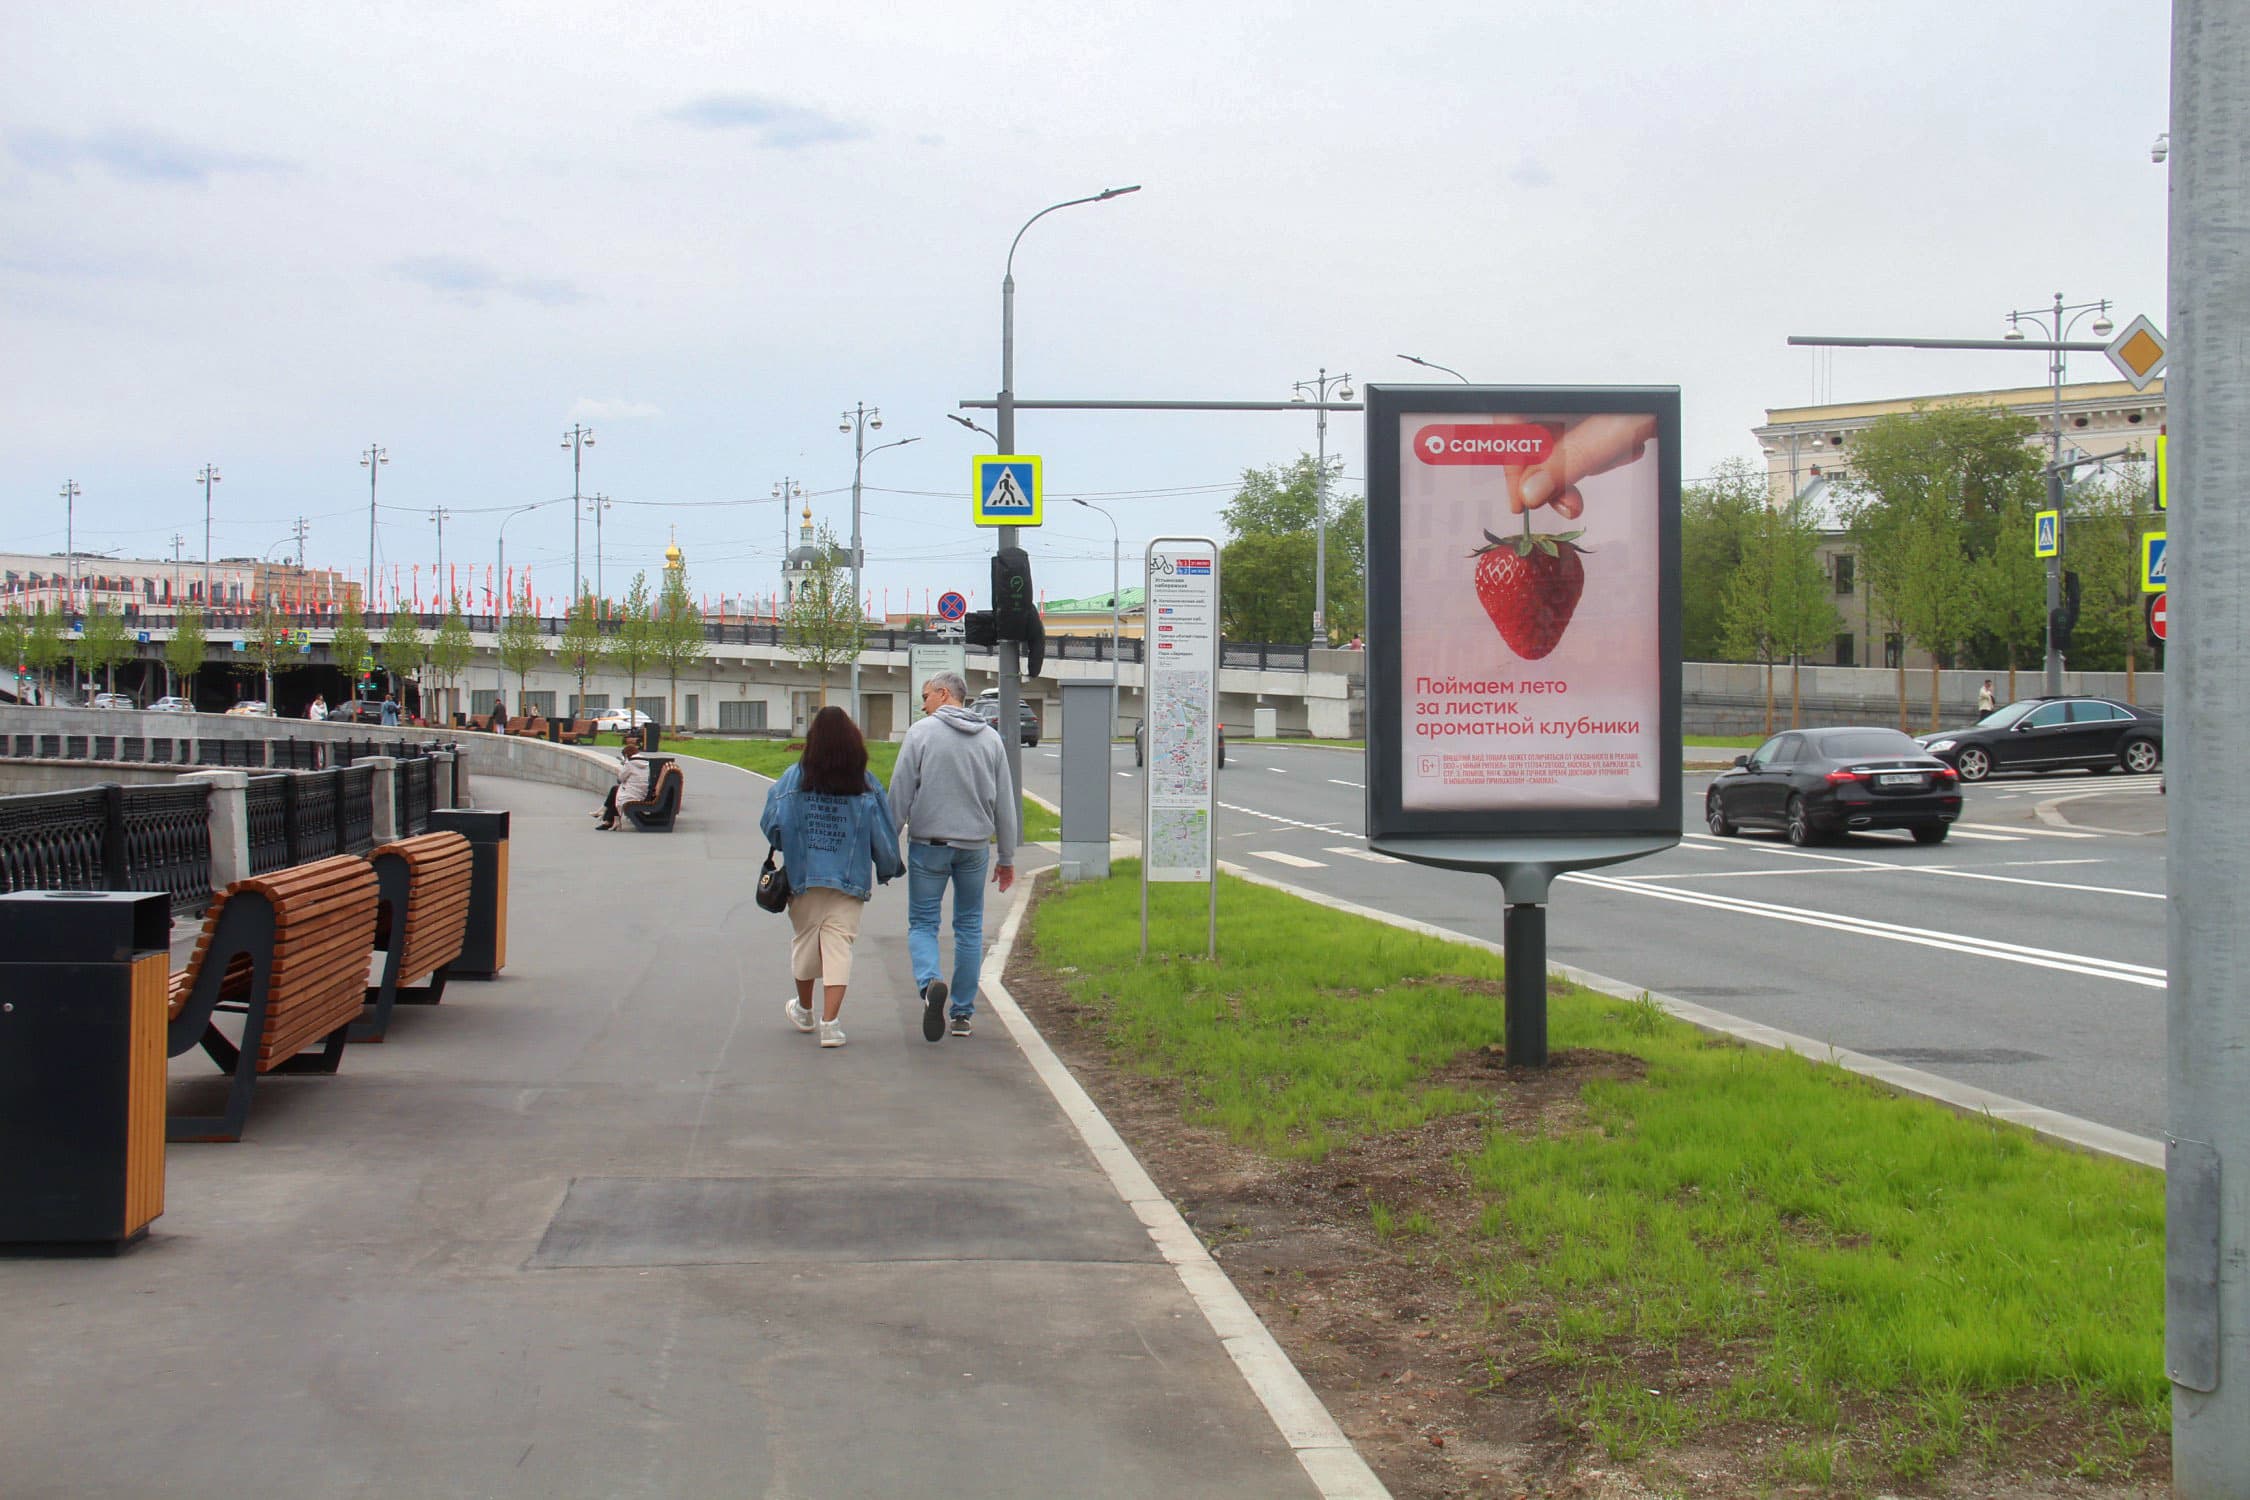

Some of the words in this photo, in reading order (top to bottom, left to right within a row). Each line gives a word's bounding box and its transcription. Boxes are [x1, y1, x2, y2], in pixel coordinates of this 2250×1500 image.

[1449, 439, 1543, 453] самокат
[1416, 677, 1514, 694] Поймаем
[1519, 680, 1567, 694] лето
[1416, 702, 1439, 715] за
[1445, 702, 1519, 715] листик
[1416, 717, 1534, 739] ароматной
[1540, 716, 1639, 738] клубники
[1422, 759, 1434, 773] 6+
